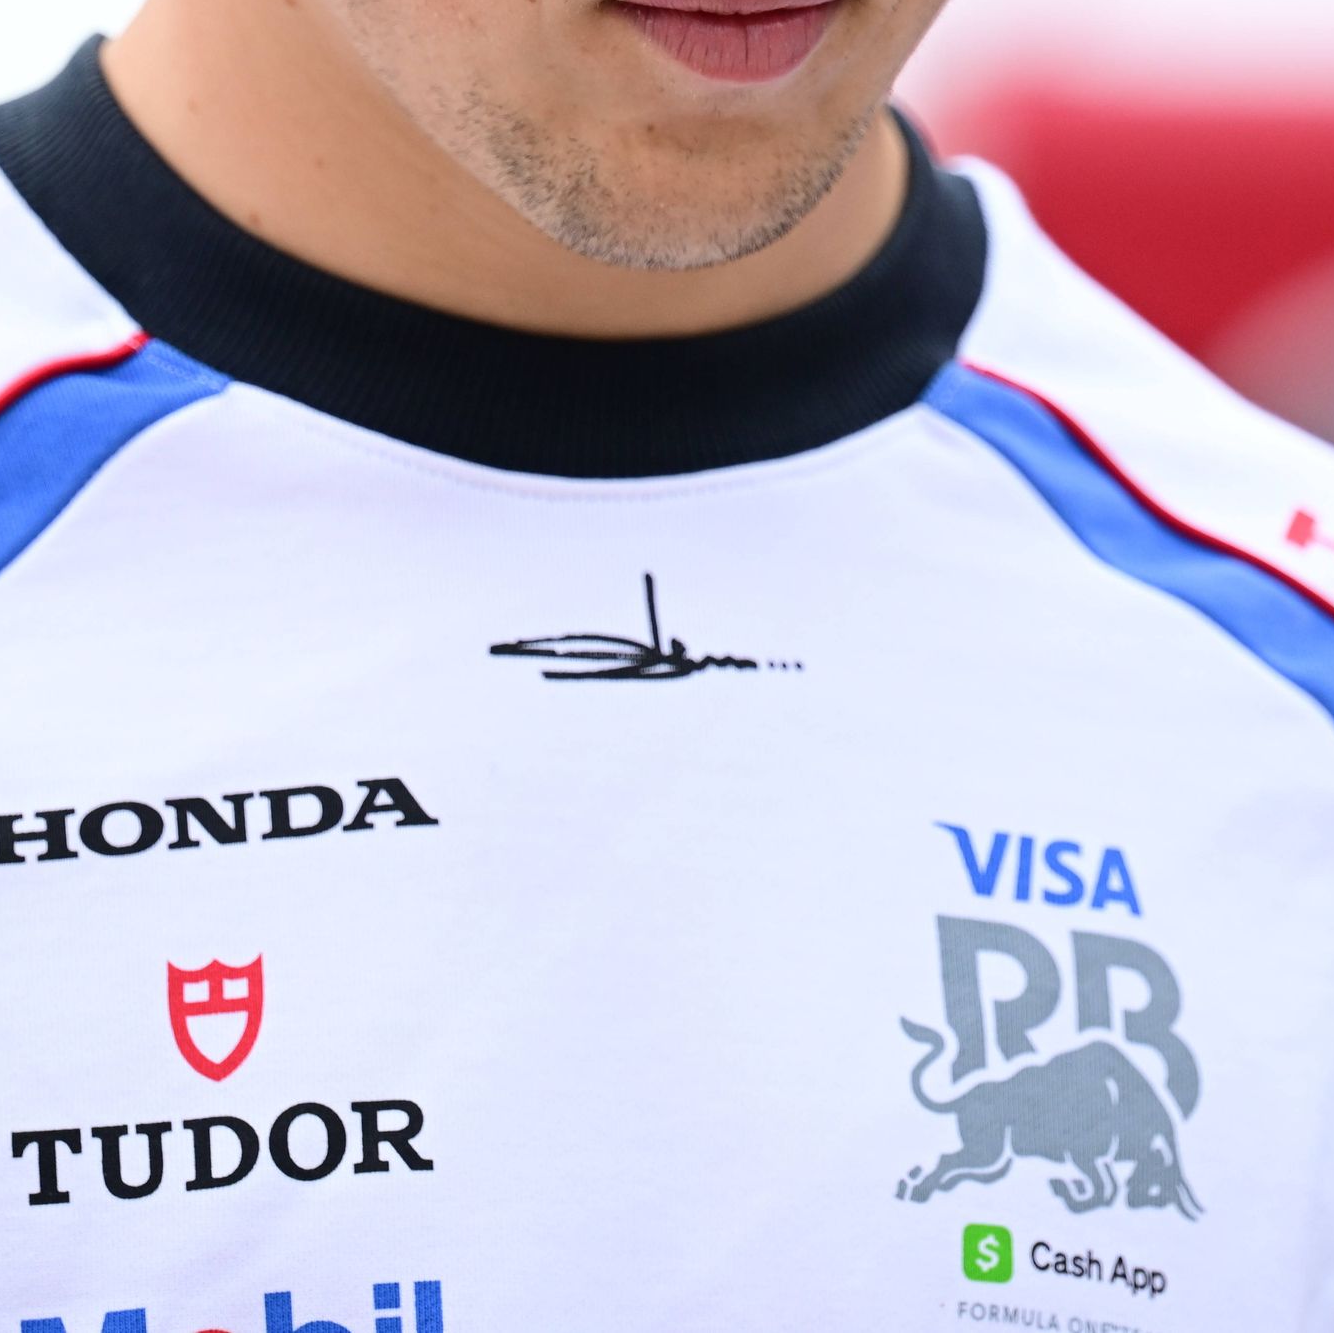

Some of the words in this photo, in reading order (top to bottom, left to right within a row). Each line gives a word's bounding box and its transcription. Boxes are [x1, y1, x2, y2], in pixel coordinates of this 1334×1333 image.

[934, 820, 1143, 918] VISA
[11, 1099, 434, 1206] TUDOR
[1030, 1241, 1102, 1281] Cash
[1110, 1255, 1166, 1298] App
[957, 1301, 1060, 1333] FORMULA
